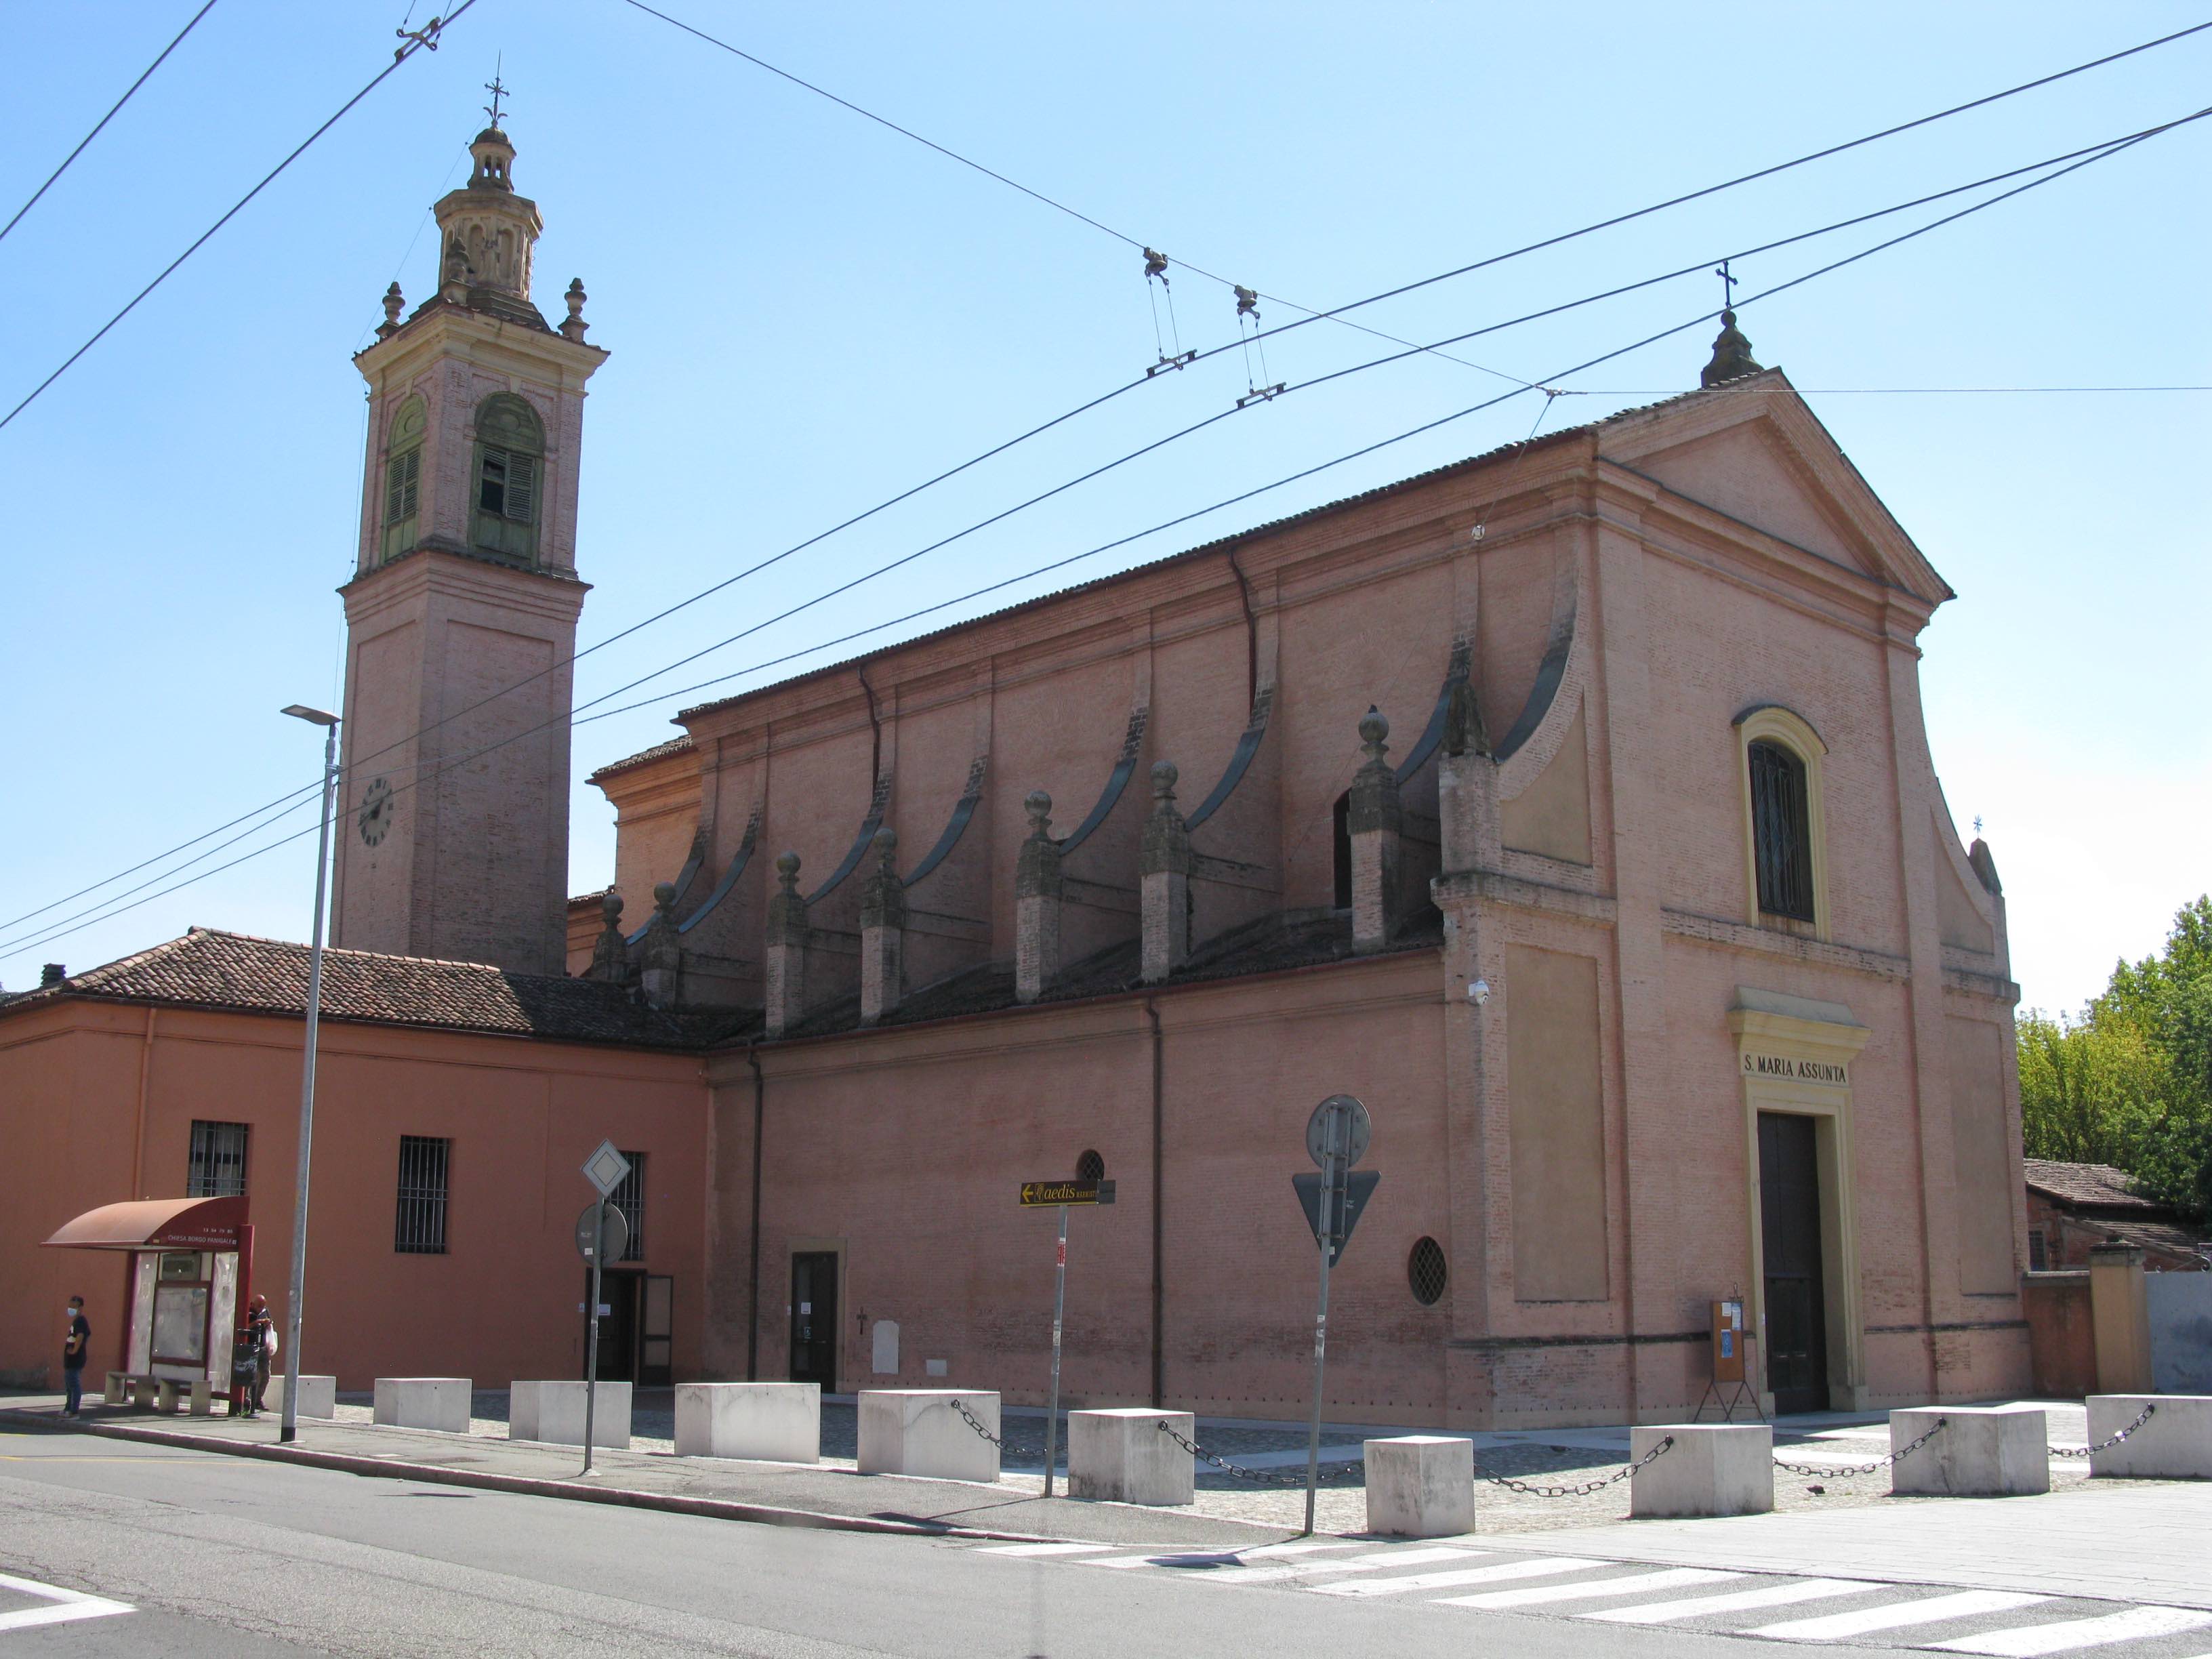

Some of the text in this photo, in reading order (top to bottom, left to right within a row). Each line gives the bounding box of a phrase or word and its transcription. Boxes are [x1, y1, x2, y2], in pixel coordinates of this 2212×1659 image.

[1744, 1054, 1847, 1083] S. MARIA ASSUNTA
[1044, 1184, 1076, 1200] aedis
